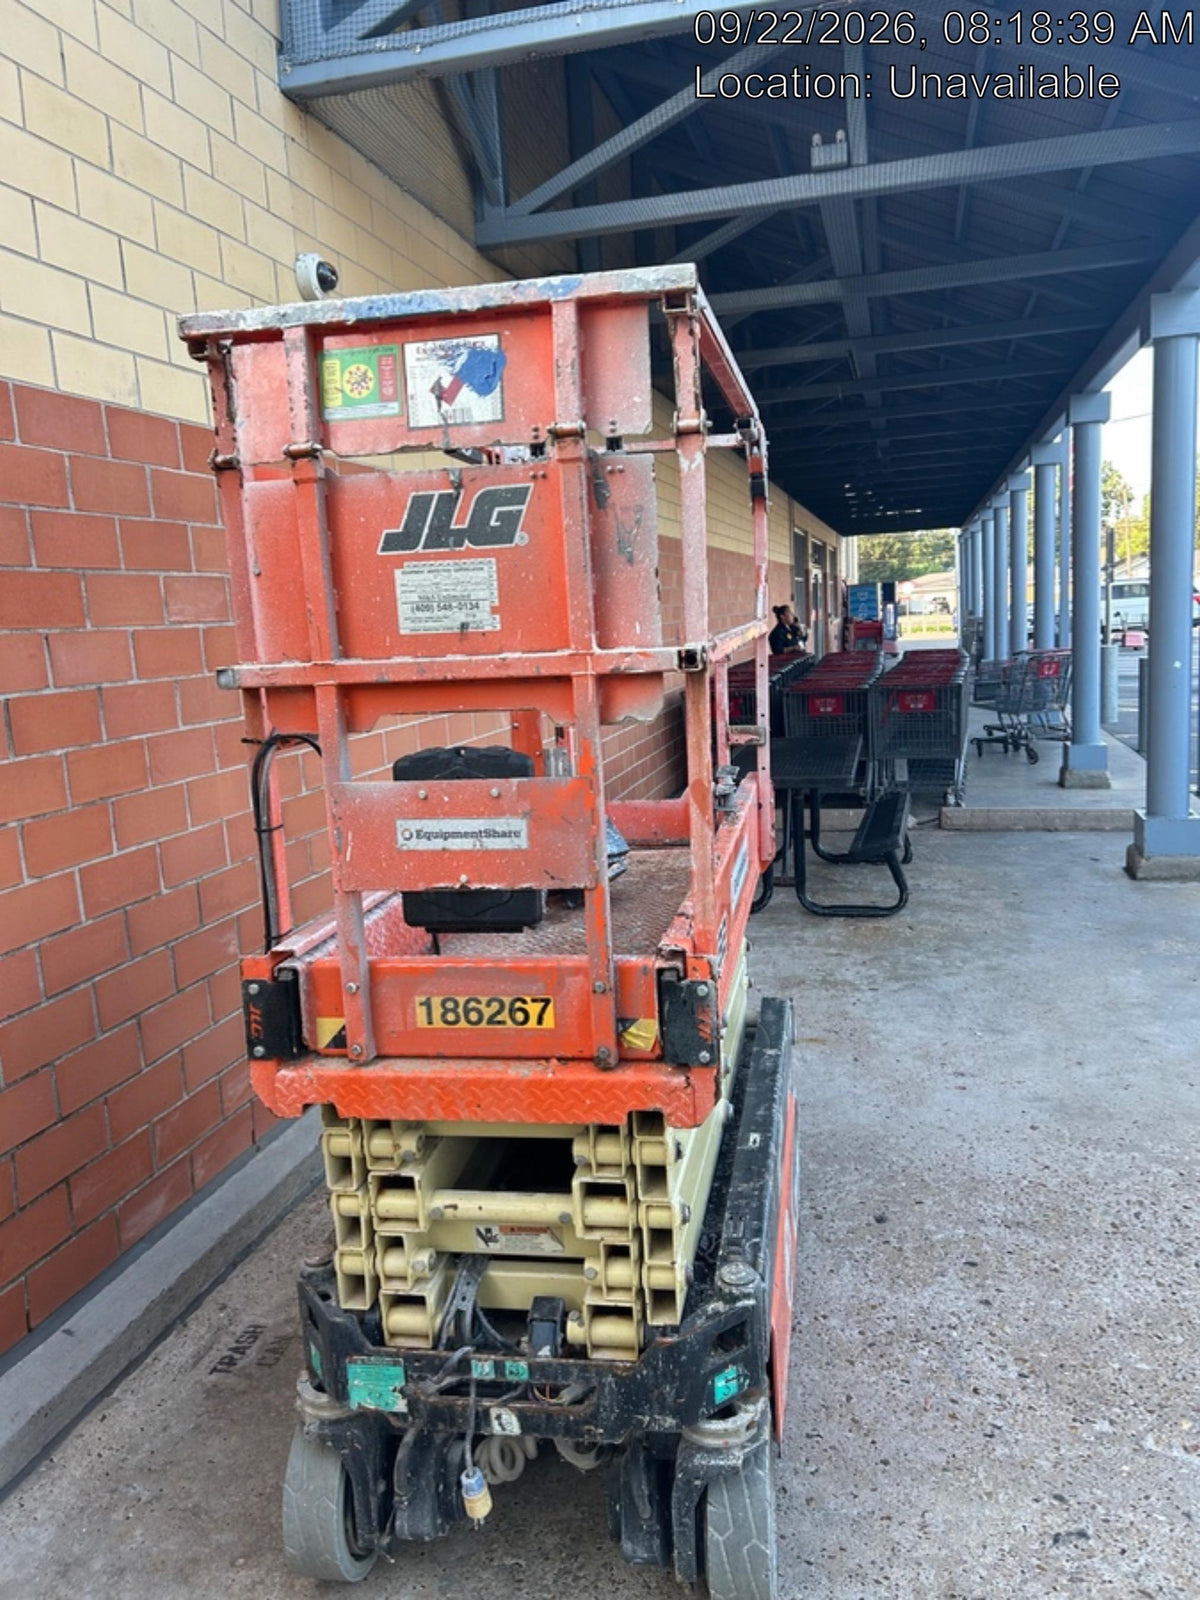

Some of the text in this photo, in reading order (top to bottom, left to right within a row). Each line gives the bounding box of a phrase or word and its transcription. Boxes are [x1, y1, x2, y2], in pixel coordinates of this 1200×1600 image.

[377, 483, 534, 555] JLG
[415, 828, 523, 841] EquipmentShare
[418, 997, 552, 1026] 186267
[207, 1324, 268, 1376] TRASH
